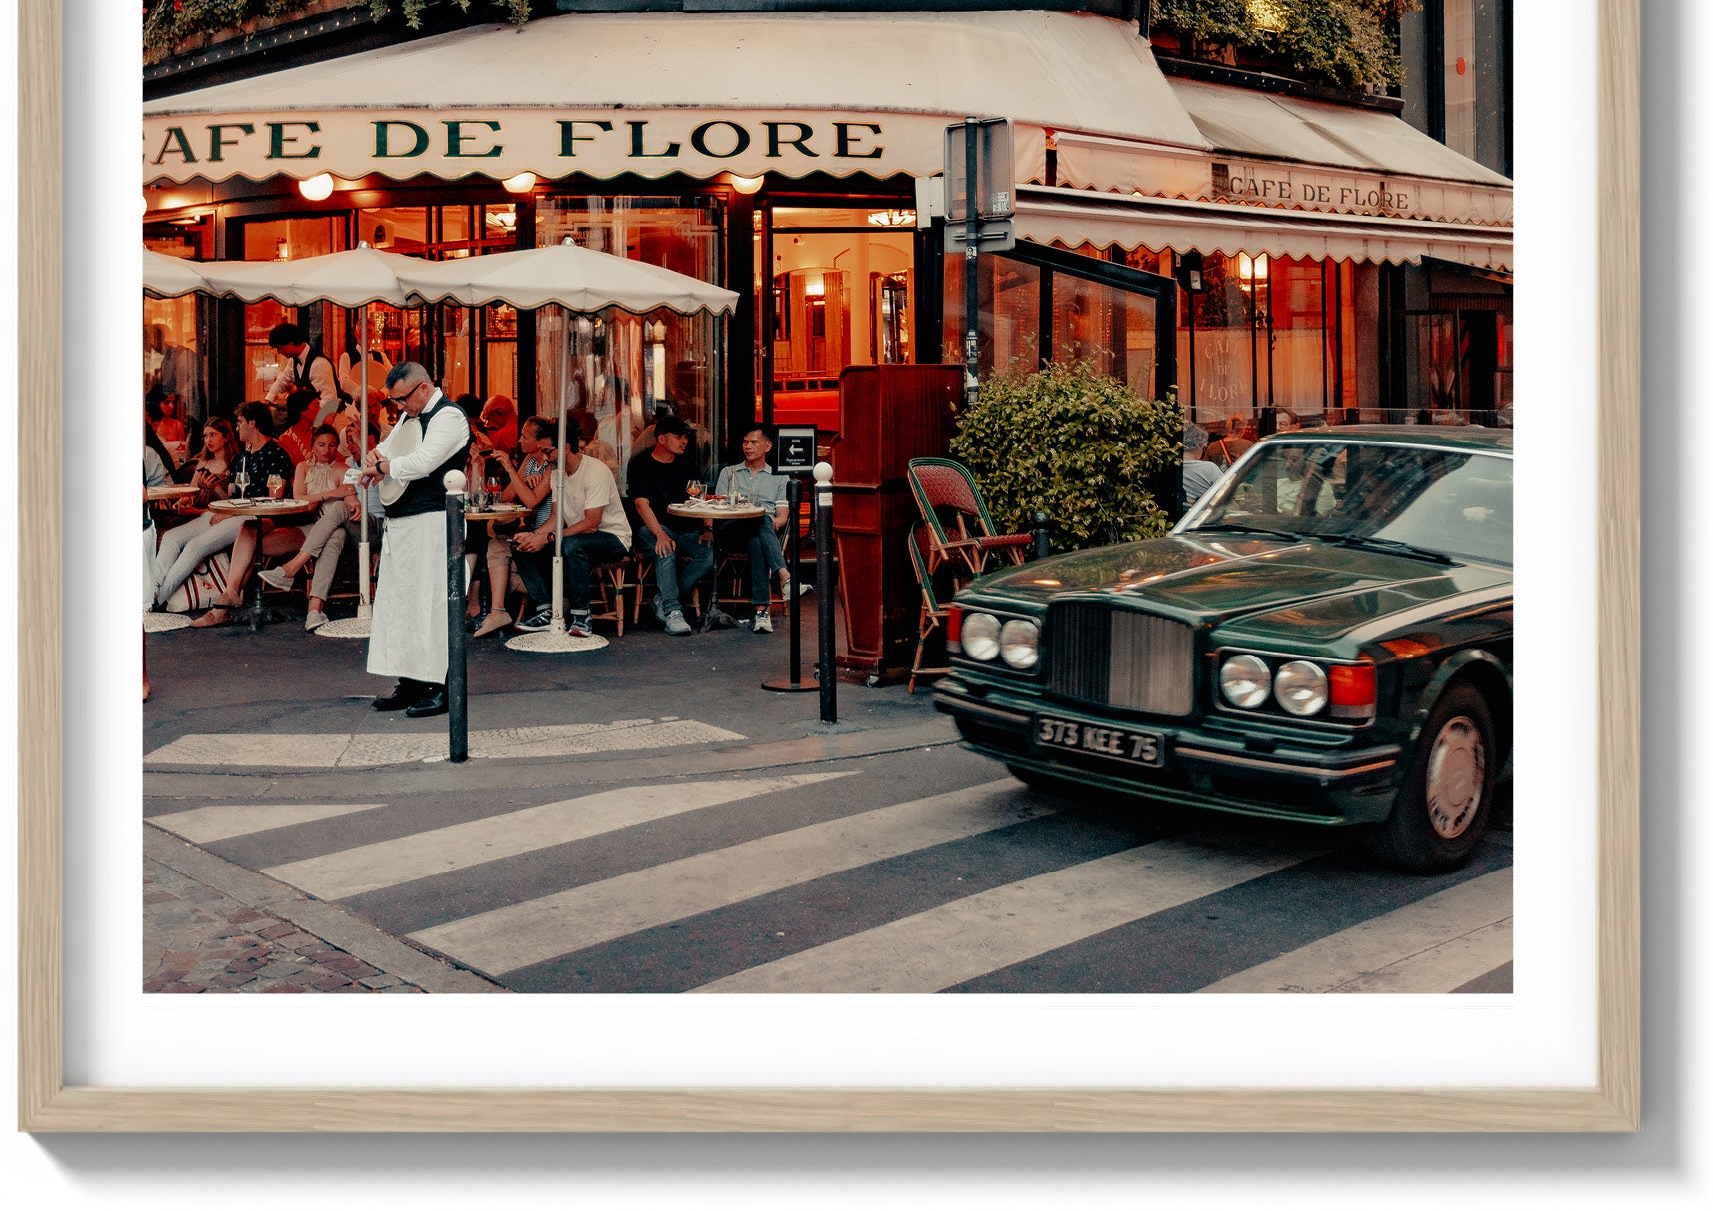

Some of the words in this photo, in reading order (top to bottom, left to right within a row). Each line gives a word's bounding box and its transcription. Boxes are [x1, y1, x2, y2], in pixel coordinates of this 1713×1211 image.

[143, 120, 322, 165] AFE
[369, 120, 503, 159] DE
[555, 119, 885, 160] FLORE
[1229, 177, 1292, 200] CAFE
[1302, 184, 1331, 203] DE
[1340, 187, 1409, 210] FLORE
[1129, 735, 1157, 761] 75
